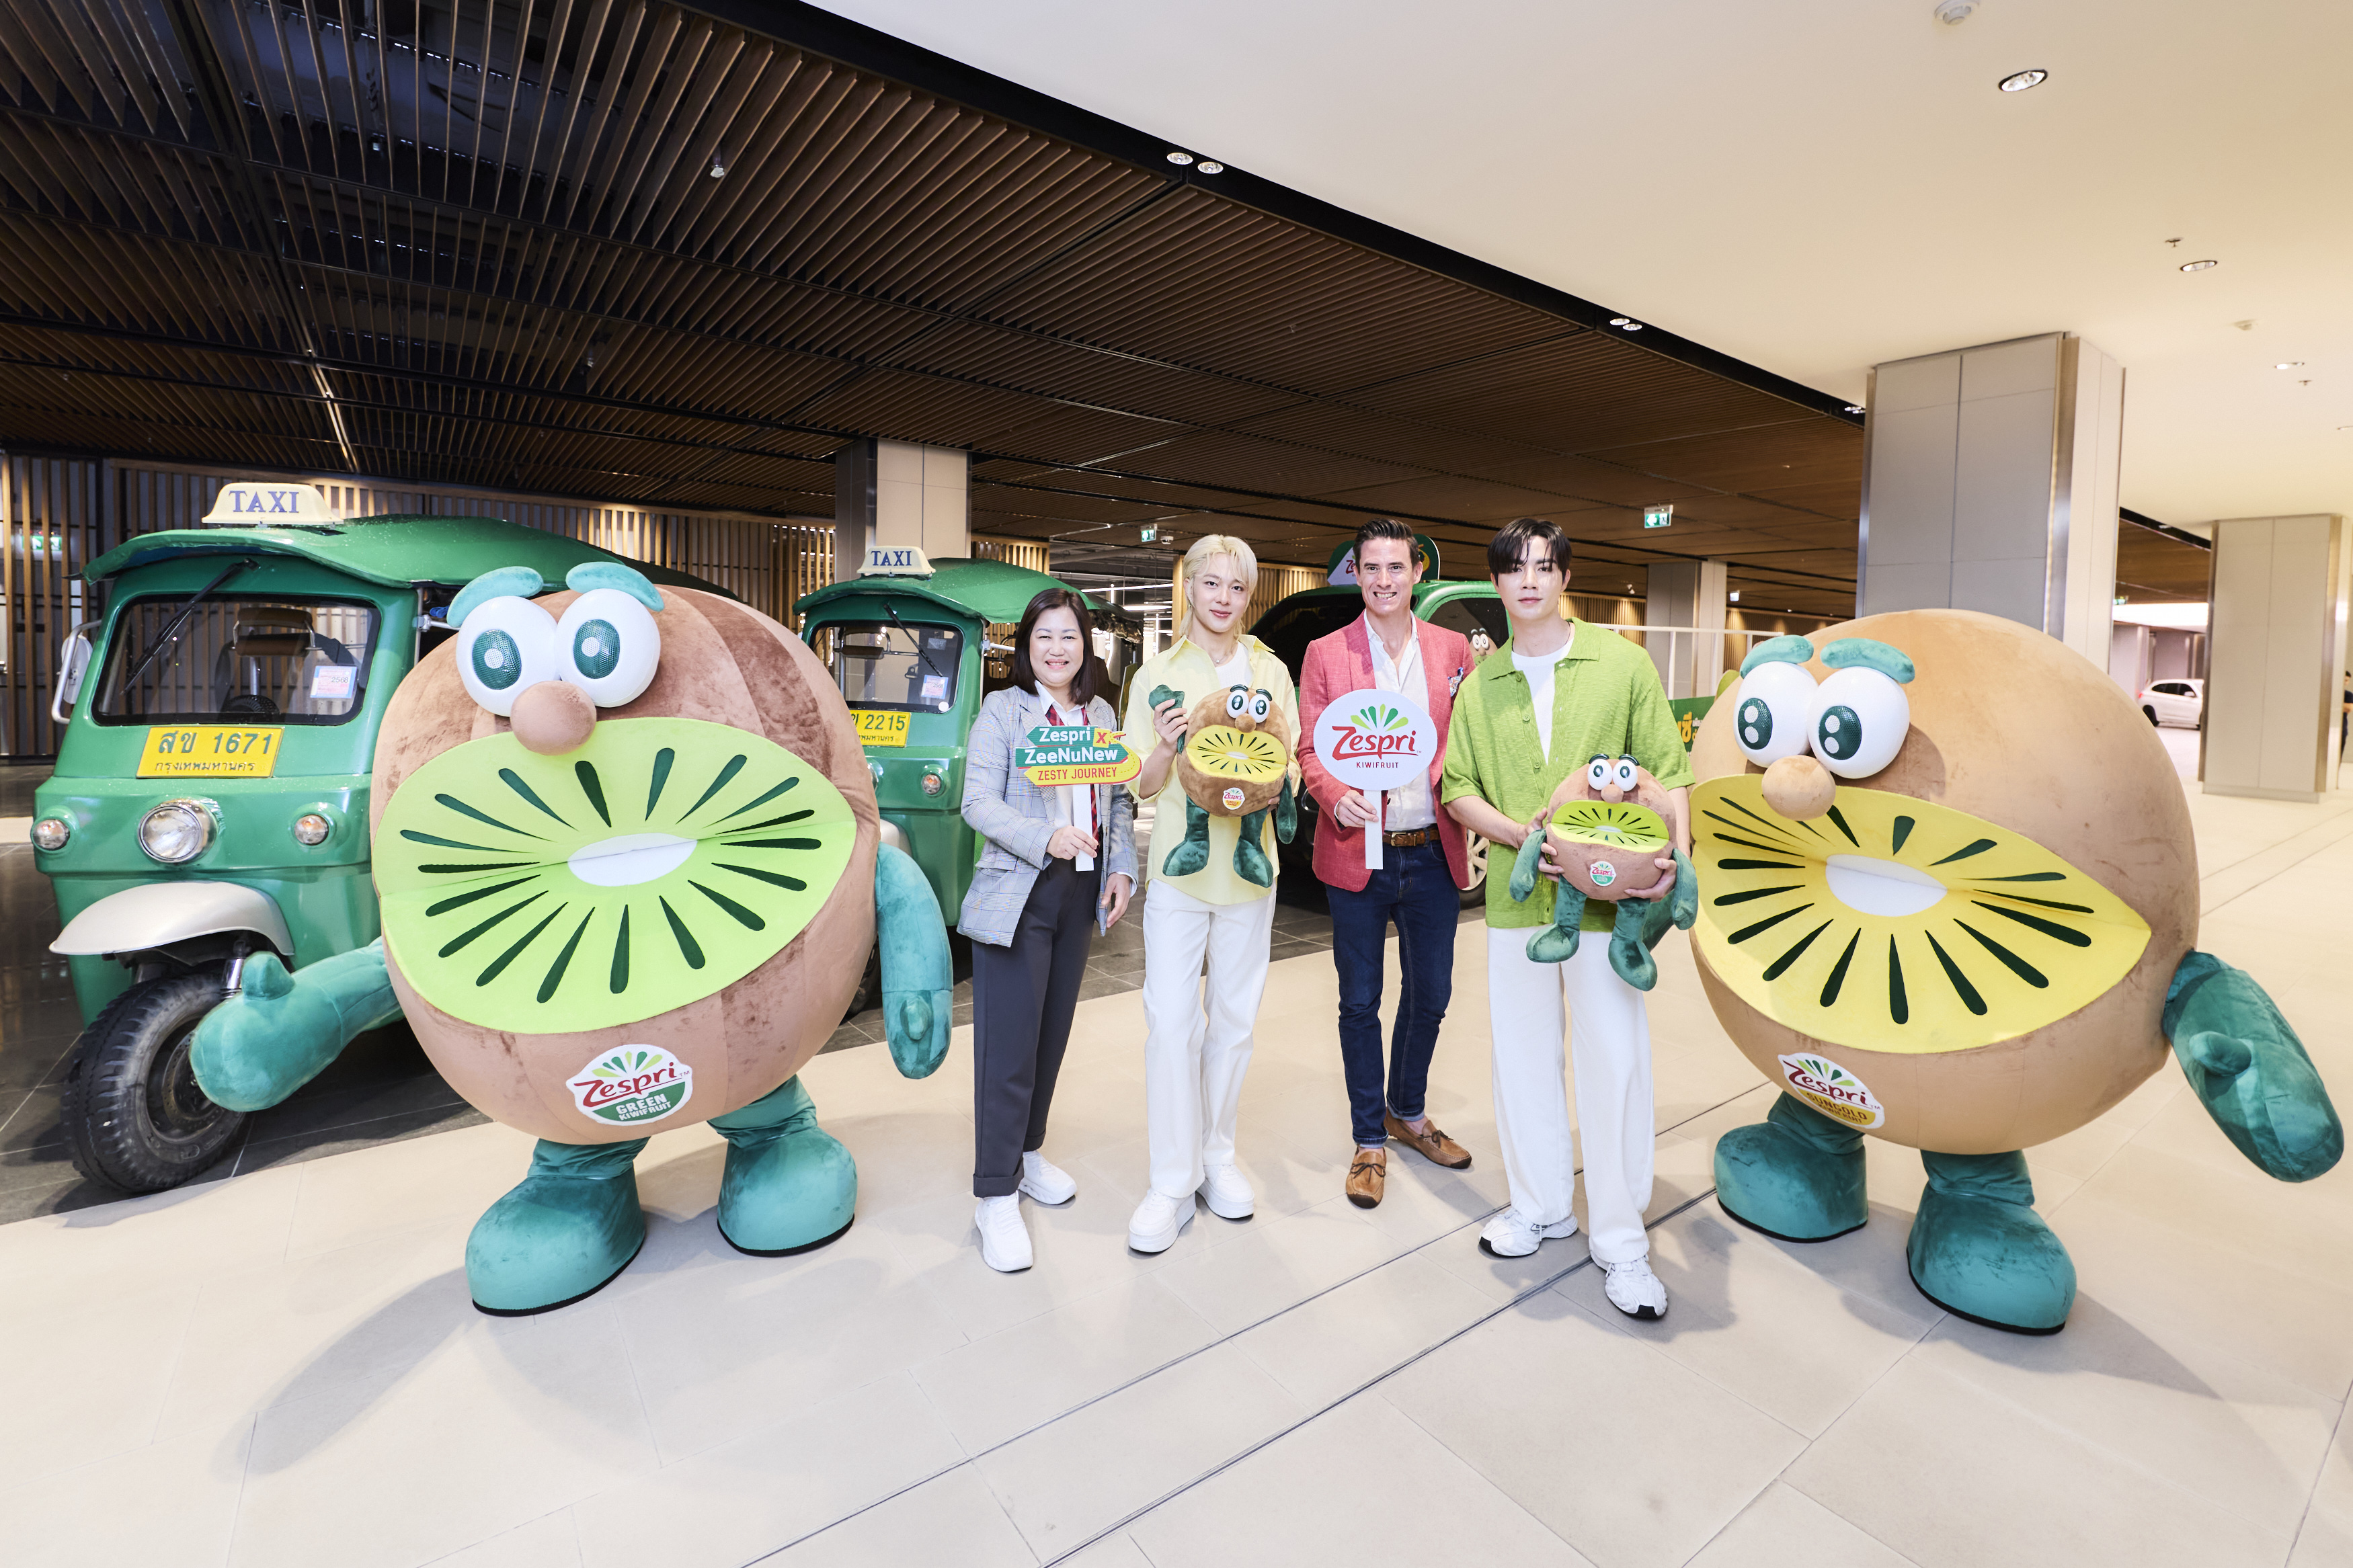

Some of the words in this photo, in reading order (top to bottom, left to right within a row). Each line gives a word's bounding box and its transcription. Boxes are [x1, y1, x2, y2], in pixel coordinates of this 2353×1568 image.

[229, 491, 299, 513] TAXI
[871, 551, 912, 566] TAXI
[865, 714, 906, 731] 2215
[159, 731, 197, 753] สข
[214, 731, 274, 754] 1671
[1039, 727, 1090, 745] Zespri
[1332, 726, 1419, 761] Zespri
[1025, 747, 1118, 764] ZeeNuNew
[155, 761, 255, 774] กรุงเทพมหานคร
[1038, 770, 1068, 780] ZESTY
[1072, 767, 1117, 779] JOURNEY
[1224, 792, 1242, 800] Zespri
[1592, 866, 1613, 876] Zespri
[573, 1062, 682, 1108] Zespri
[1783, 1060, 1872, 1110] Zespri
[616, 1094, 668, 1114] GREEN
[619, 1102, 672, 1120] KIWIFRUIT
[1807, 1092, 1868, 1120] SUNGOLD
